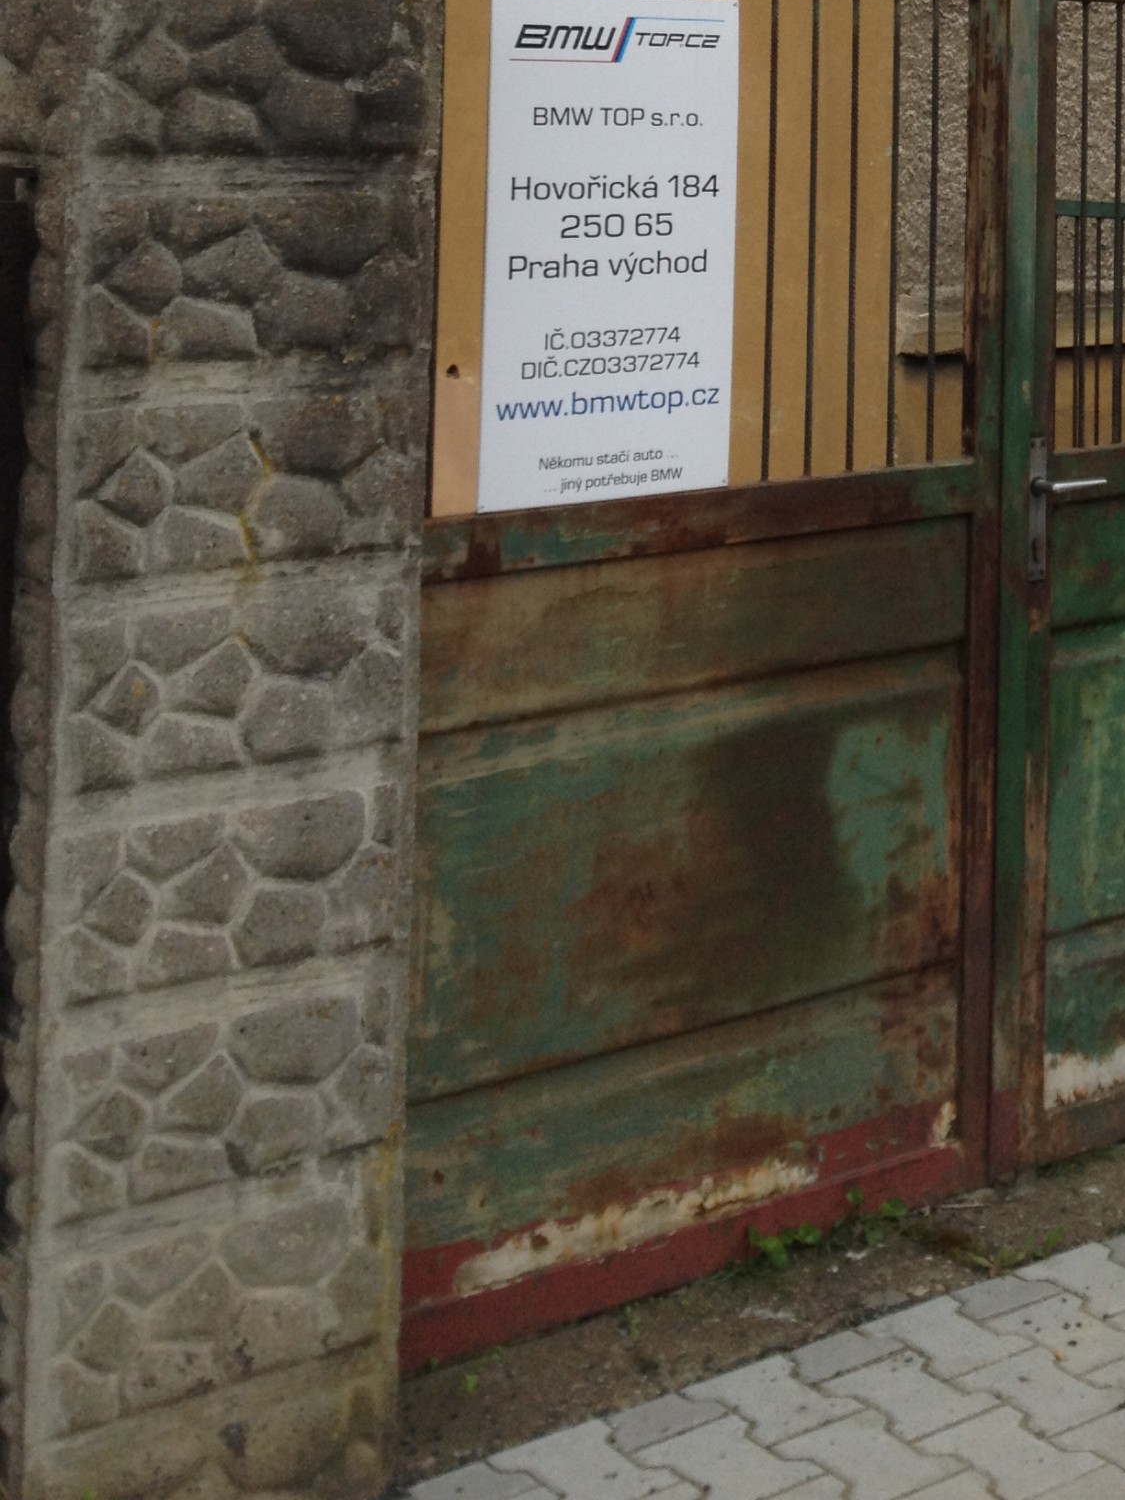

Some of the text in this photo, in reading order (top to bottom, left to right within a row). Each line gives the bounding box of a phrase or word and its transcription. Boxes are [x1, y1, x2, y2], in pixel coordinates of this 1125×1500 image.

[514, 24, 617, 51] BMW
[533, 107, 704, 127] BMW TOP s.r.o.
[511, 174, 720, 201] Hovořická 184
[561, 212, 674, 239] 250 65
[508, 249, 708, 283] Praha východ
[544, 326, 681, 351] IČ.03372774
[521, 351, 701, 380] DIČ.CZ03372774
[496, 387, 720, 422] www.bmwtop.cz
[538, 455, 593, 471] Někomu
[596, 449, 630, 466] stačí
[633, 449, 663, 462] auto
[560, 477, 582, 494] jiný
[585, 473, 648, 491] potřebuje
[650, 466, 683, 482] BMW
